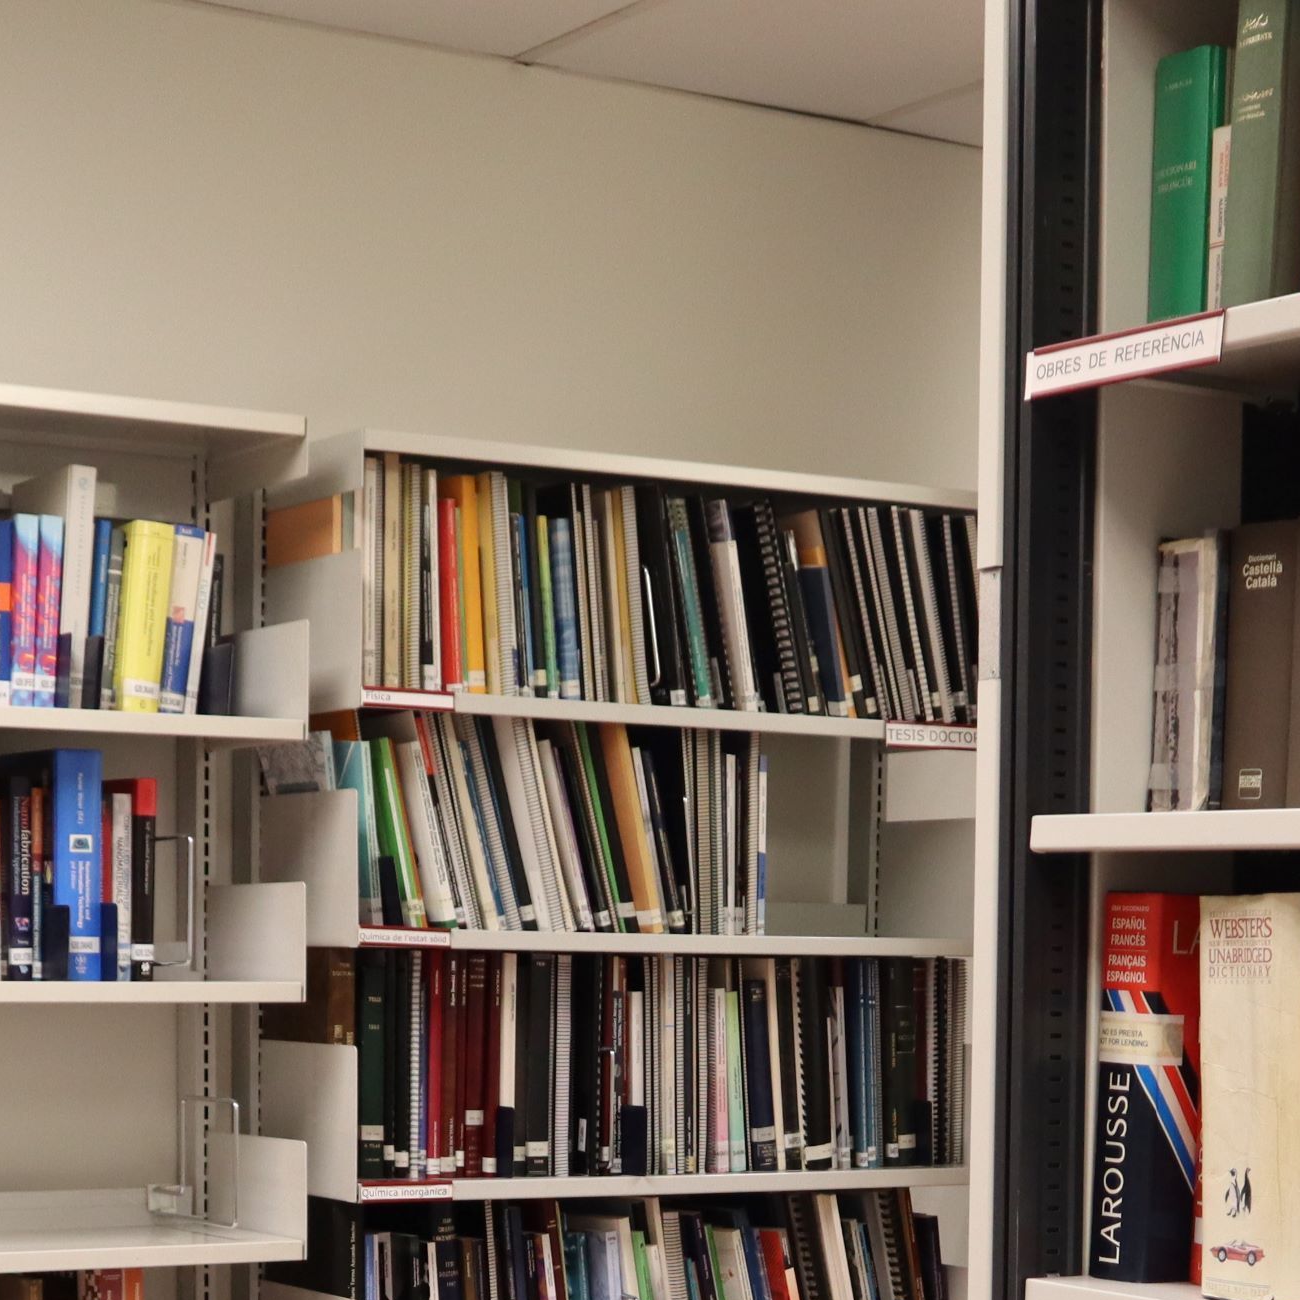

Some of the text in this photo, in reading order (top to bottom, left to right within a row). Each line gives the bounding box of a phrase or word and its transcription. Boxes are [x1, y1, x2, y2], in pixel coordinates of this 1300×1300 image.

[1036, 329, 1205, 380] OBRES DE REFERÈNCIA
[1242, 560, 1283, 577] Castellà
[1246, 576, 1277, 590] Català
[365, 690, 391, 701] Física
[887, 728, 925, 741] TESIS
[1112, 915, 1147, 930] ESPAÑOL
[1209, 917, 1273, 939] WEBSTER'S
[360, 932, 447, 943] Química de l'estat sòlid
[1111, 933, 1146, 947] FRANCÉS
[1108, 954, 1146, 969] FRANÇAIS
[1208, 947, 1273, 964] UNABRIDGED
[1106, 970, 1147, 984] ESPAGNOL
[1208, 965, 1272, 977] DICTIONARY
[1098, 1070, 1132, 1265] LAROUSSE
[362, 1186, 448, 1198] Química inorgànica
